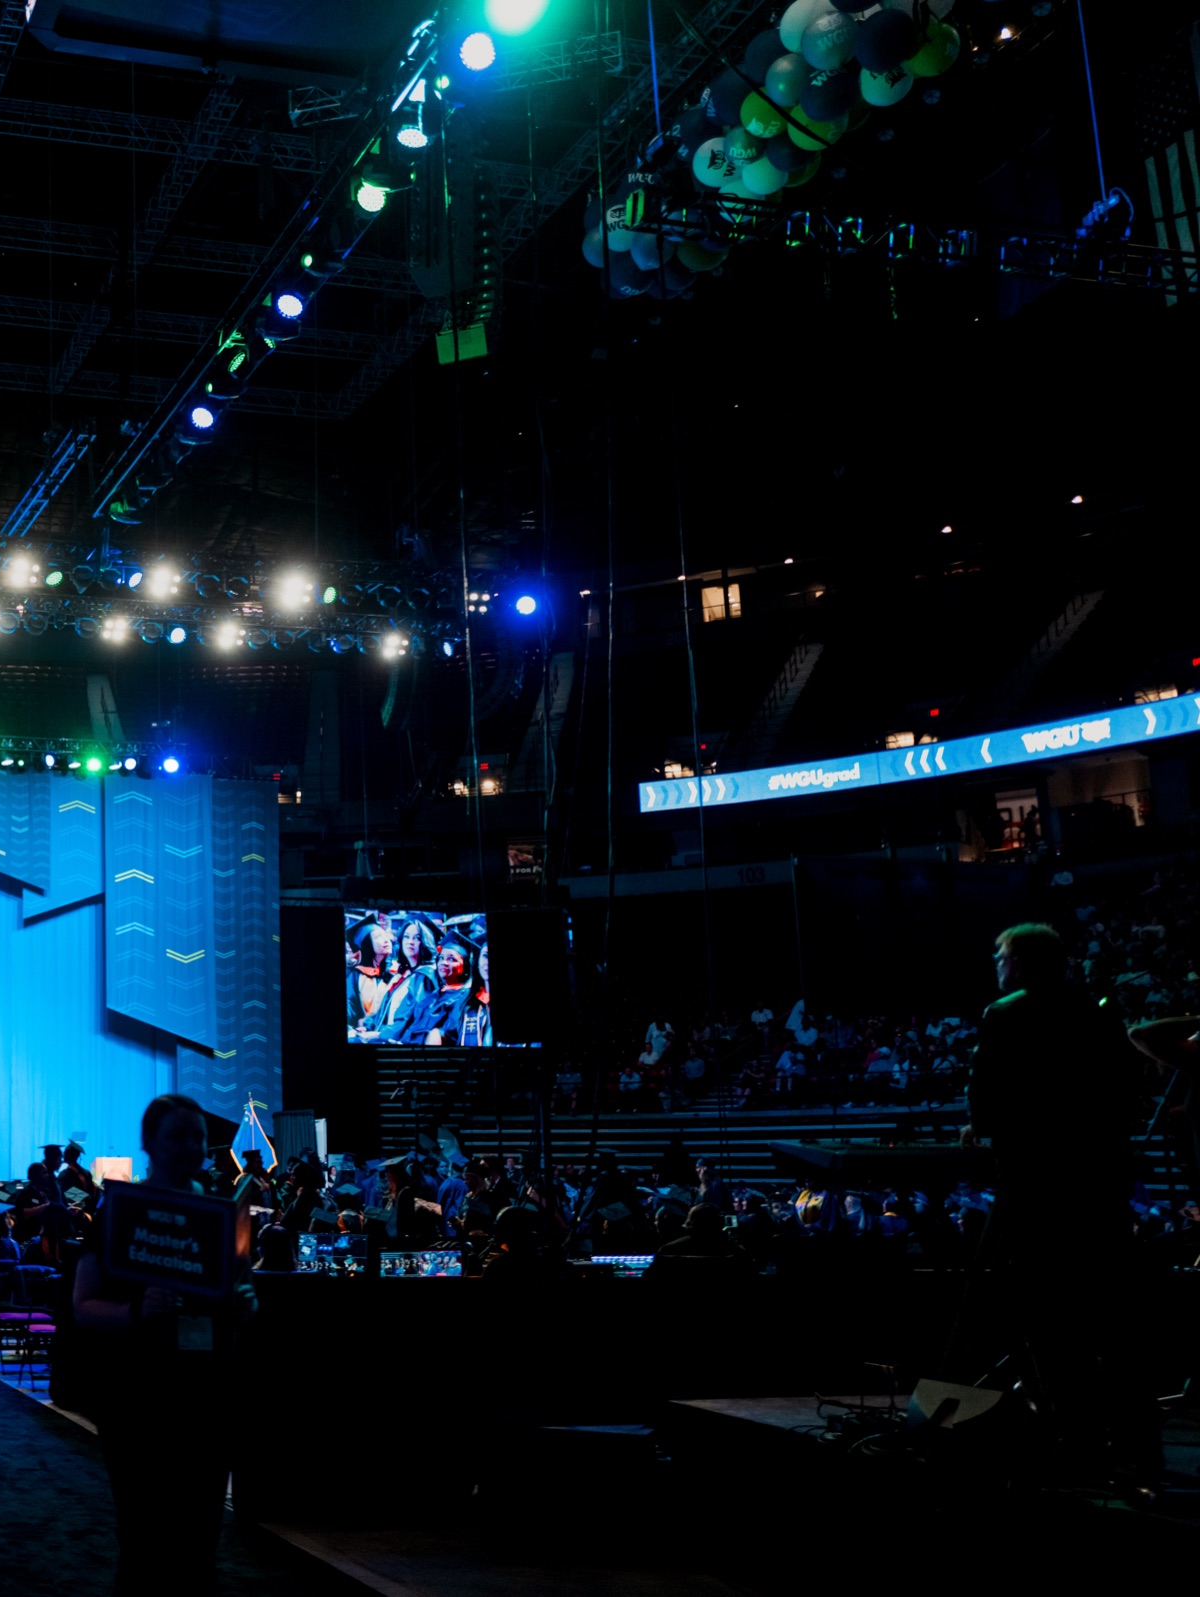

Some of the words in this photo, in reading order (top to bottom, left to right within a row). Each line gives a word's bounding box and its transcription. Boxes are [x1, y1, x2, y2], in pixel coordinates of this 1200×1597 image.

[1022, 724, 1080, 753] WGU
[768, 763, 860, 790] #WGUgrad
[738, 866, 765, 884] 103
[134, 1226, 199, 1254] Master's
[128, 1245, 204, 1275] Education
